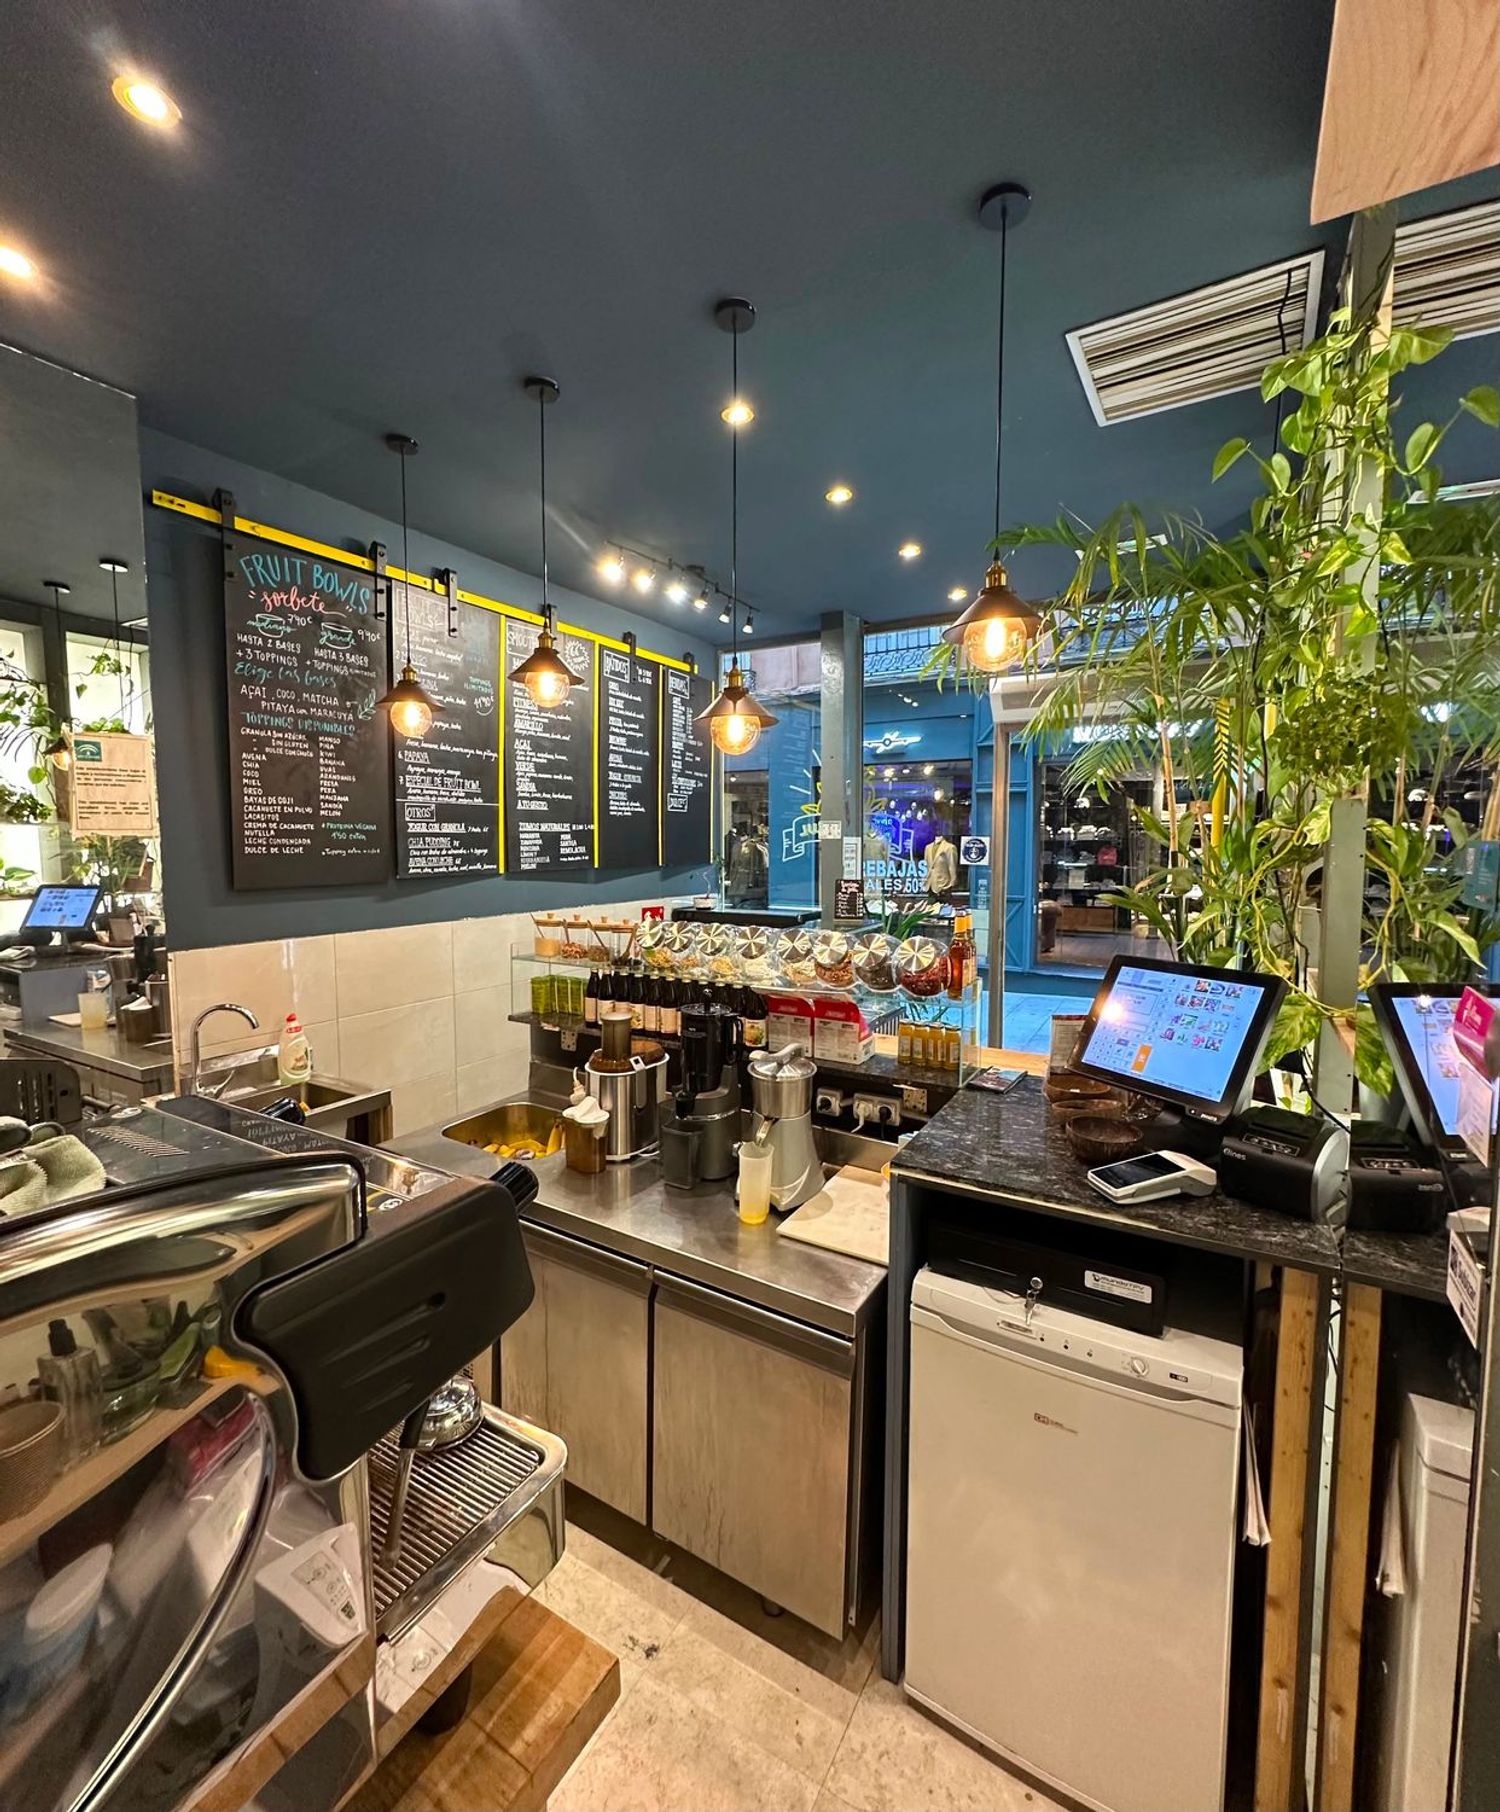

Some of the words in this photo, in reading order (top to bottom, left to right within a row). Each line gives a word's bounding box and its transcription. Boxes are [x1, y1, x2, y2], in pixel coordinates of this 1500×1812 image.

[239, 553, 307, 588] FRUIT
[312, 564, 370, 615] BOWLS
[237, 633, 264, 647] HASTA
[267, 638, 273, 648] 2
[275, 641, 301, 654] BASES
[254, 650, 298, 667] TOPPINGS
[313, 647, 337, 661] HASTA
[339, 651, 345, 662] 3
[345, 652, 369, 668] BASES
[312, 659, 349, 676] TOPPINGS
[234, 661, 273, 684] Elige
[302, 693, 339, 706] MATCHA
[261, 701, 296, 714] PITAYA
[241, 711, 294, 730] TOPPINGS
[298, 718, 356, 737] DISPONIBLES
[240, 727, 271, 738] GRANOLA
[284, 740, 309, 749] GLUTEN
[242, 752, 267, 761] AVENA
[319, 758, 345, 767] BANANA
[242, 770, 260, 778] COCO
[319, 766, 336, 774] UVAS
[242, 778, 261, 786] MIEL
[319, 780, 339, 788] FRESA
[243, 787, 263, 795] OREO
[243, 796, 267, 804] BAYAS
[267, 796, 277, 805] DE
[278, 797, 294, 805] GOJI
[319, 794, 349, 802] MANZANA
[243, 804, 282, 813] CACAHUETE
[244, 822, 267, 830] CREMA
[268, 822, 277, 830] DE
[244, 837, 267, 845] LECHE
[244, 846, 267, 854] DULCE
[282, 846, 304, 854] LECHE
[863, 860, 928, 877] EBAJAS
[864, 879, 902, 891] ALES
